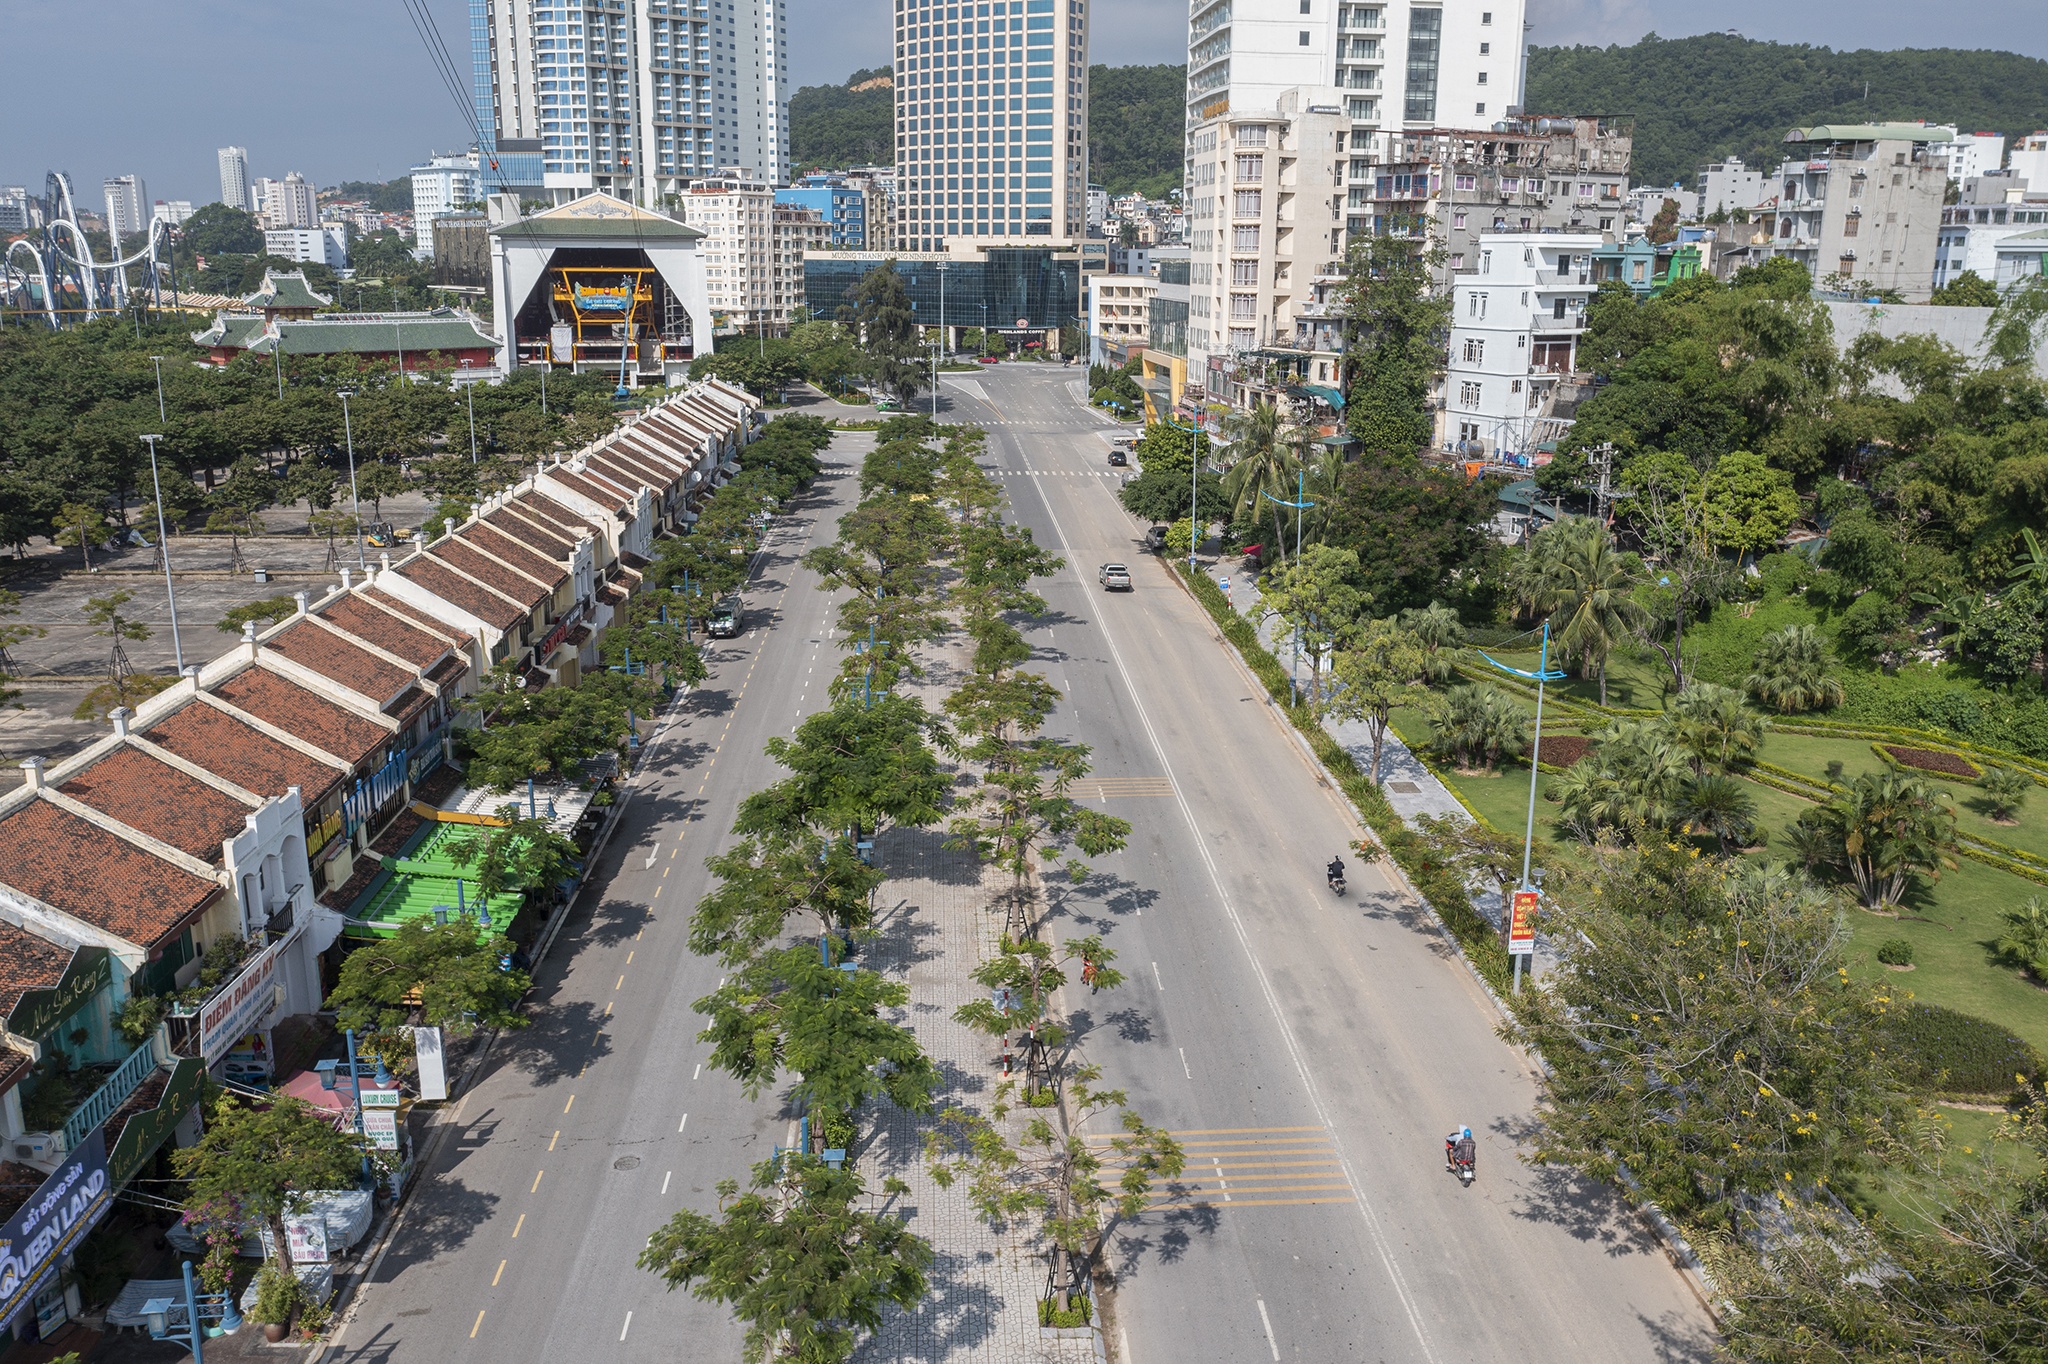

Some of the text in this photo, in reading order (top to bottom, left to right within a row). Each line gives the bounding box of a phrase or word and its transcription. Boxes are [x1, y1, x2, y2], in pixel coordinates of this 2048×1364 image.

[205, 994, 232, 1034] ĐIỂM
[234, 967, 261, 1006] ĐĂNG
[262, 950, 275, 978] KÝ
[362, 1093, 398, 1104] LUXURY CRUISE
[39, 1182, 66, 1217] ĐỘNG
[0, 1216, 61, 1300] QUEEN
[60, 1168, 105, 1231] LAND
